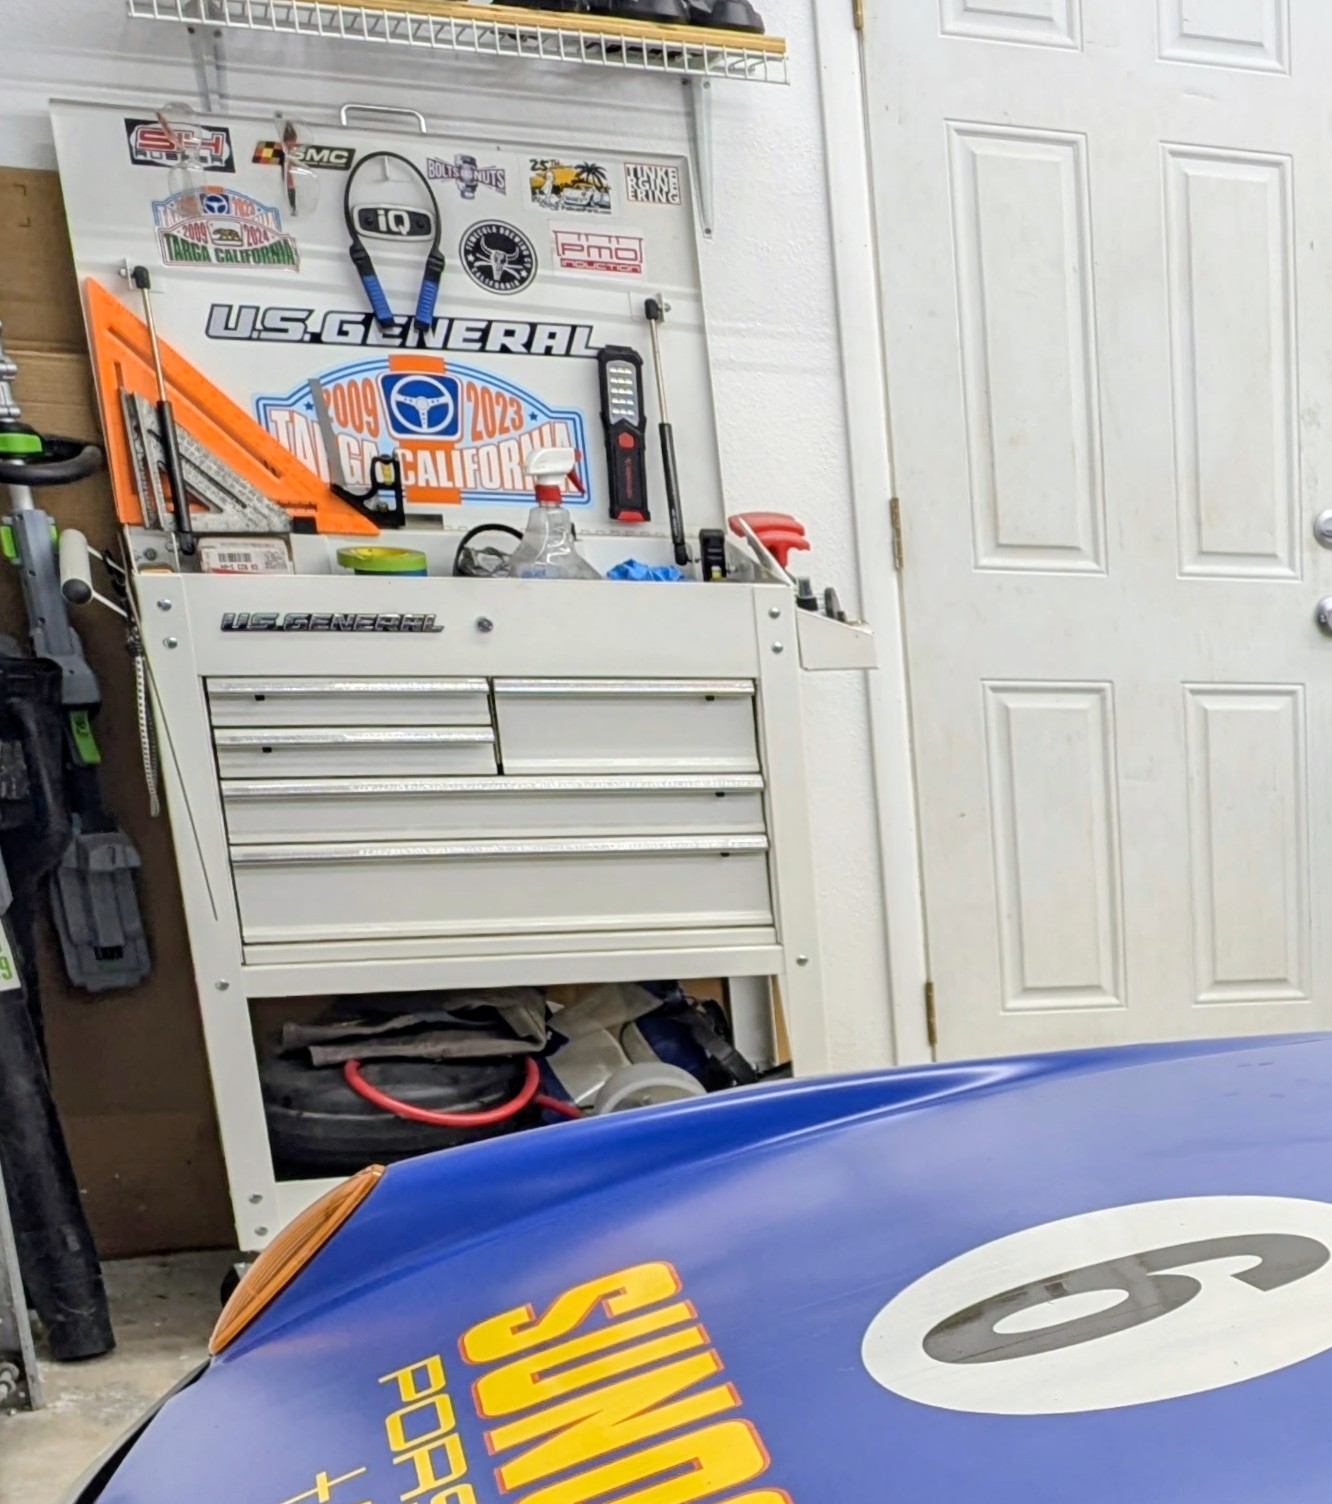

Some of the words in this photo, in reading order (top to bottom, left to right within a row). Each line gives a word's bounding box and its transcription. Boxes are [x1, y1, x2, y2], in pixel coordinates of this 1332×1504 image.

[428, 160, 460, 178] BOLTS
[474, 169, 505, 188] NUTS
[182, 222, 208, 244] 2009
[243, 224, 270, 247] 2024
[377, 209, 411, 235] iQ
[164, 233, 212, 262] TARGA
[214, 239, 295, 265] CALIFORNIA
[323, 377, 380, 438] 2009
[466, 382, 525, 442] 2023
[922, 1232, 1332, 1364] 6
